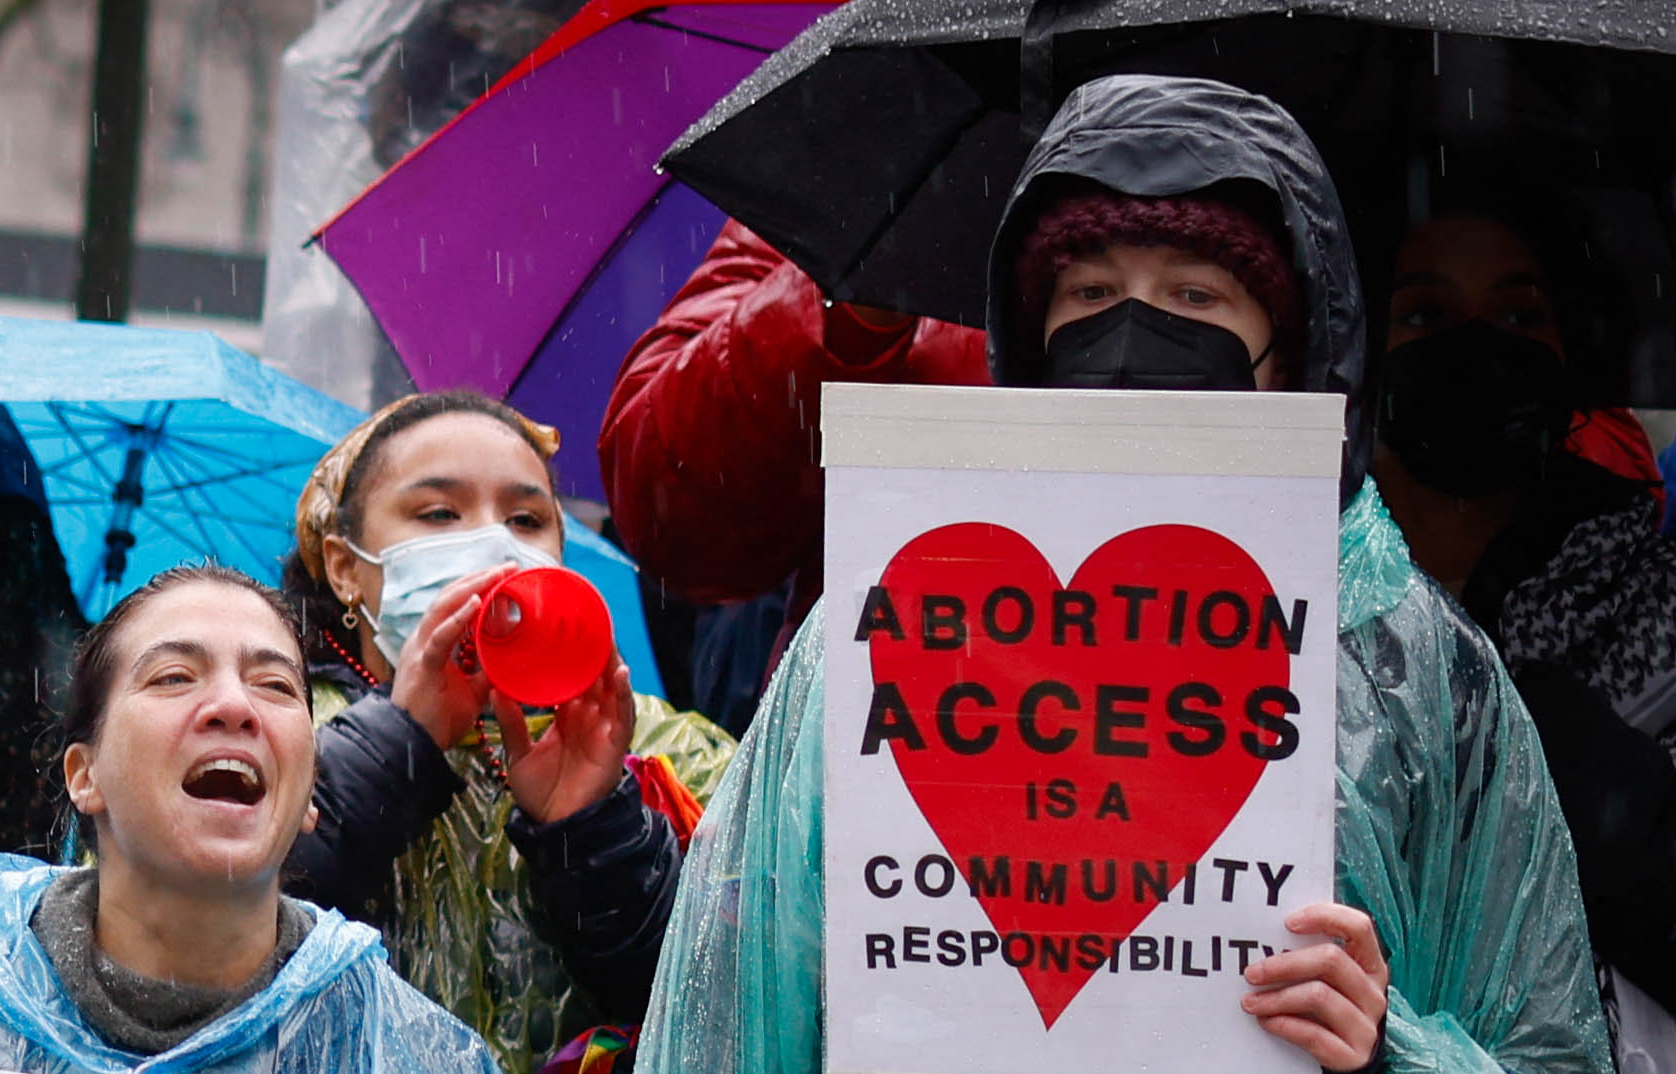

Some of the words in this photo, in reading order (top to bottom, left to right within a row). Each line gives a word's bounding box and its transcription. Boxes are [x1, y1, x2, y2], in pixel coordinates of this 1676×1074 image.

[854, 583, 1308, 656] ABORTION
[860, 681, 1302, 761] ACCESS
[1025, 780, 1078, 821] IS
[1095, 781, 1131, 822] A
[864, 854, 1295, 907] COMMUNITY
[865, 926, 1293, 978] RESPONSIBILIT
